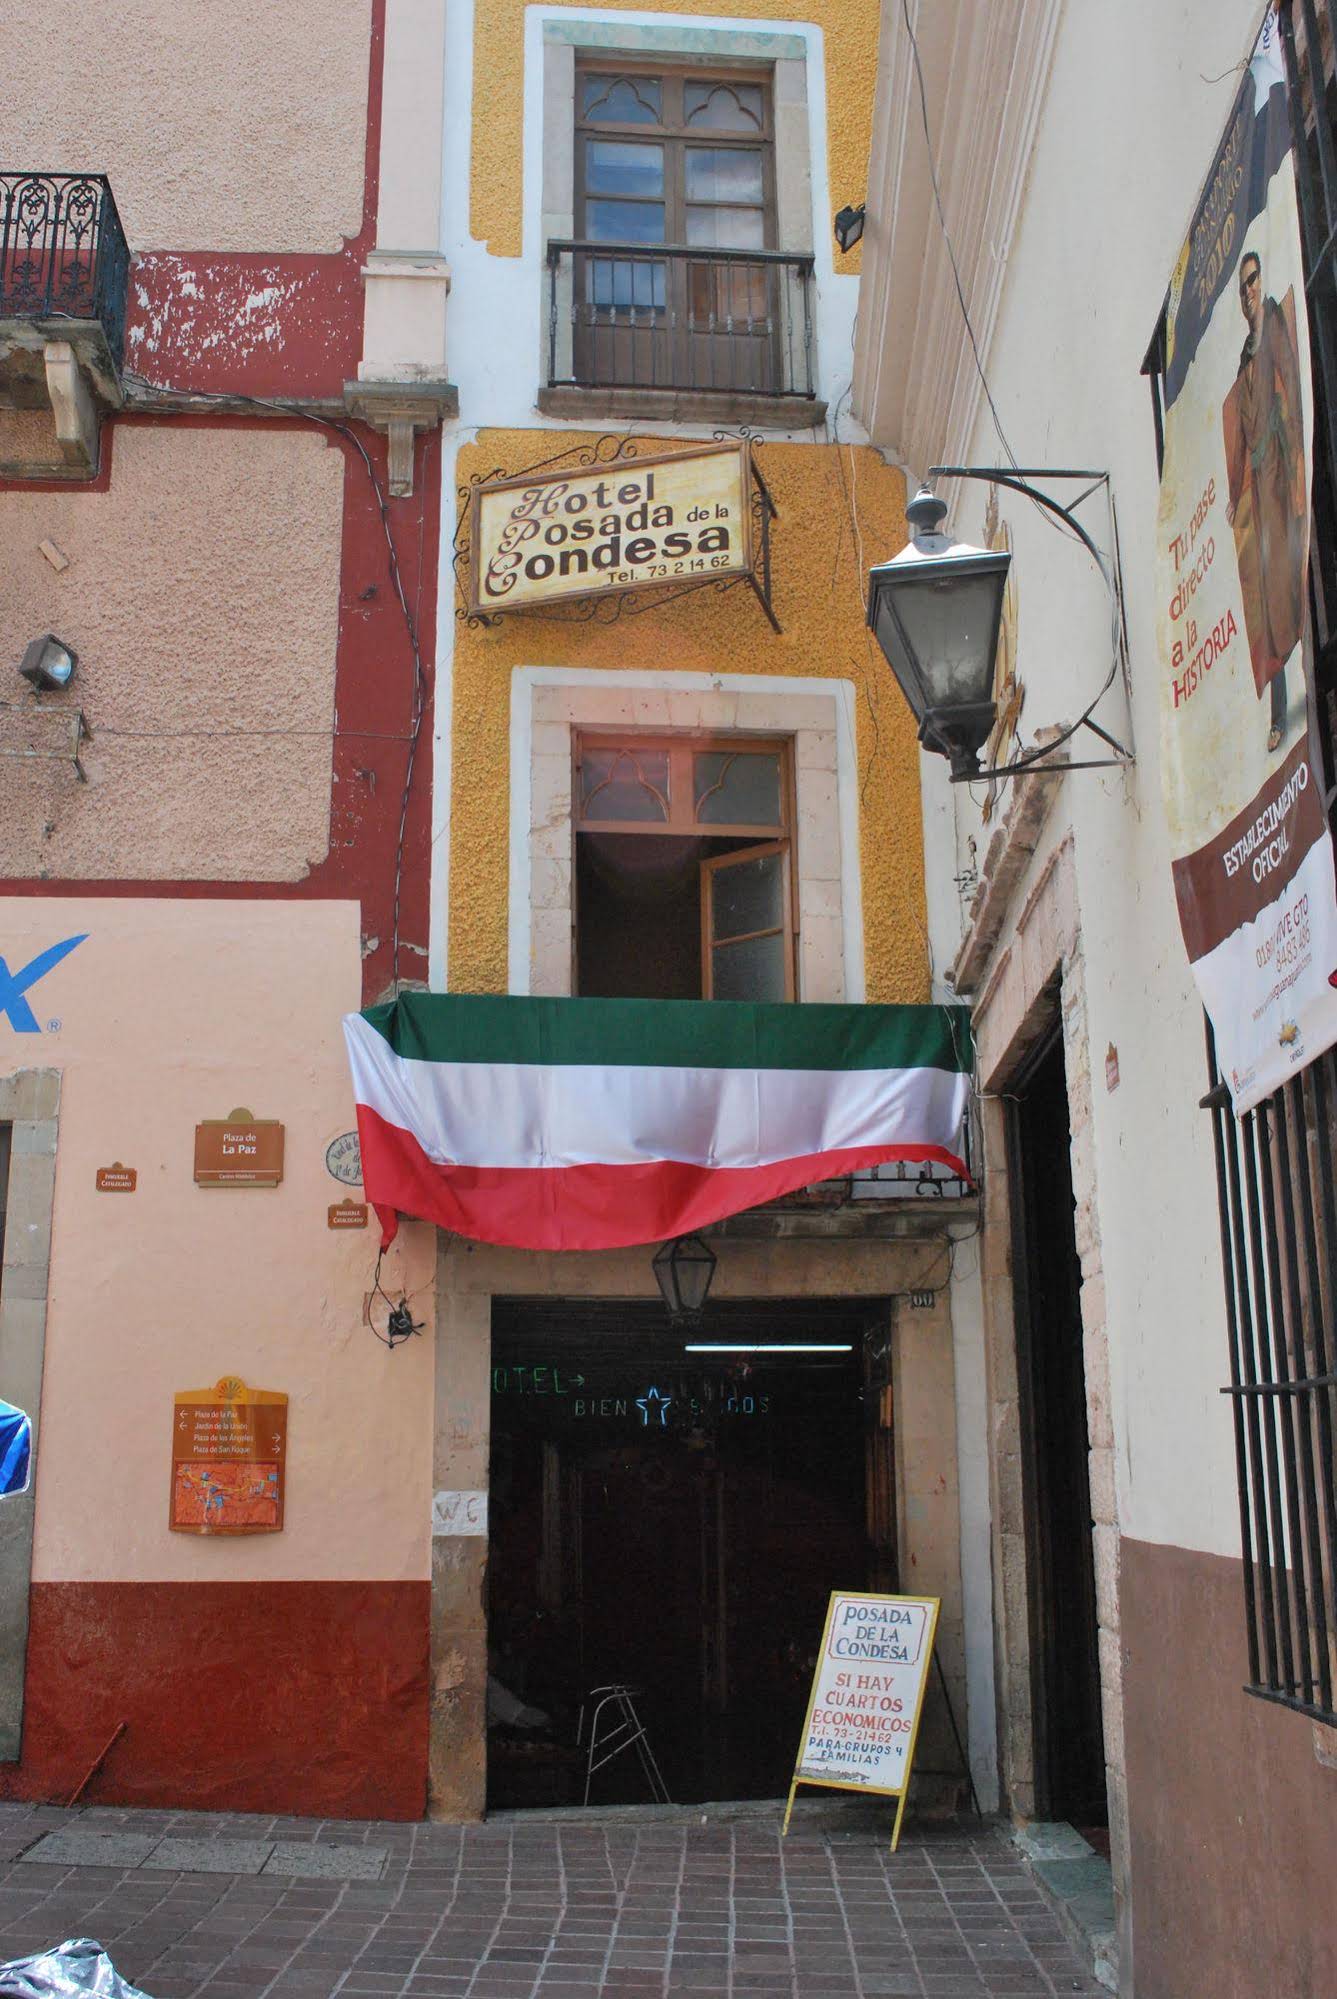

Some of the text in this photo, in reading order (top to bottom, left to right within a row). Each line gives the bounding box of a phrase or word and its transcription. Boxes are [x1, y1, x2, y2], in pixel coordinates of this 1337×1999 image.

[510, 473, 655, 521] Hotel
[499, 502, 729, 555] Posada de la
[1169, 478, 1216, 571] Tu pase
[485, 524, 730, 597] Condesa
[607, 554, 730, 584] Tel. 73 2 14 62
[1169, 537, 1216, 621] directo
[1172, 619, 1198, 668] a la
[1172, 609, 1238, 708] HISTORIA
[1293, 893, 1309, 927] GTO
[222, 1144, 257, 1155] La Paz
[223, 1132, 257, 1142] Plaza de
[492, 1368, 568, 1394] OTEL
[195, 1410, 210, 1418] Plaza
[843, 1606, 912, 1625] POSADA
[856, 1626, 899, 1642] DE LA
[836, 1637, 908, 1660] CONDESA
[835, 1672, 895, 1691] SI HAY
[825, 1690, 903, 1713] CUARTOS
[812, 1709, 912, 1733] ECONOMICOS
[821, 1750, 880, 1765] FAMILIAS
